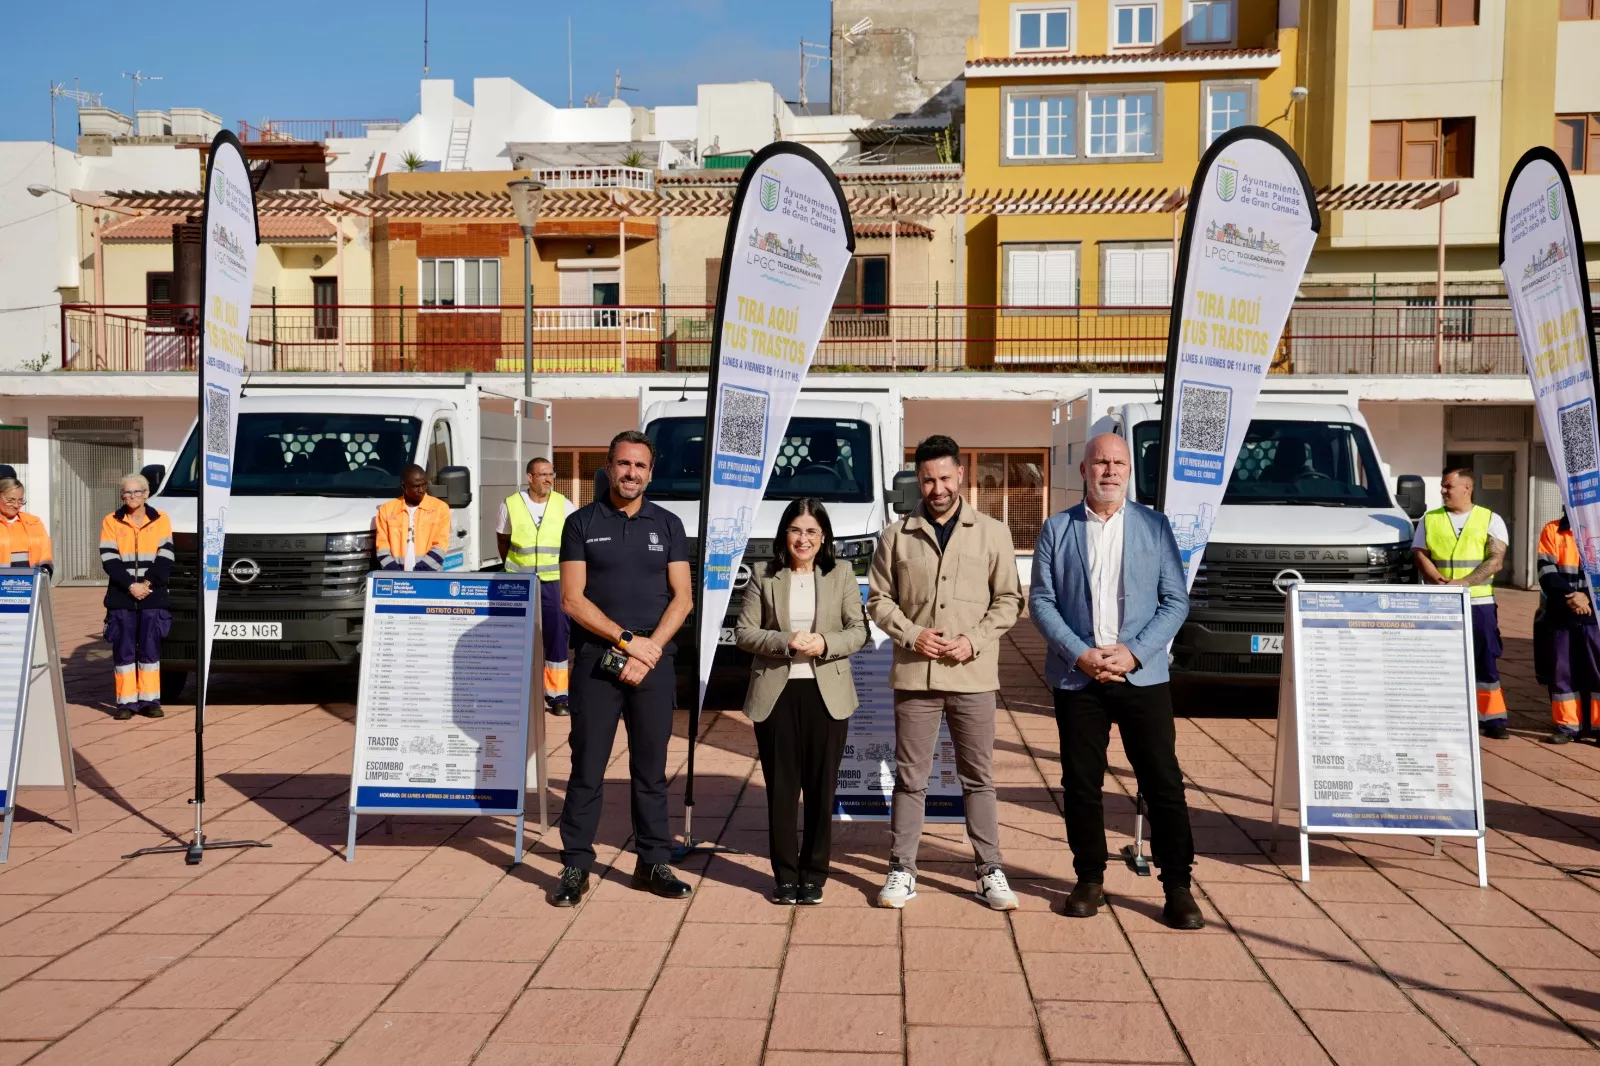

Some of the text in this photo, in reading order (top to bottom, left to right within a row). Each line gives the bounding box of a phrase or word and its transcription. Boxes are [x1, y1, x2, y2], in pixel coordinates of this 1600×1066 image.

[1242, 174, 1300, 196] Ayuntamiento
[784, 186, 838, 215] Ayuntamiento
[1240, 194, 1299, 216] de Gran Canaria
[1241, 185, 1300, 206] de Las Palmas
[782, 206, 836, 234] de Gran Canaria
[783, 197, 837, 225] de Las Palmas
[746, 251, 776, 272] LPGC
[1204, 245, 1235, 263] LPGC
[737, 295, 800, 335] TIRA AQUÍ
[1196, 289, 1262, 325] TIRA AQUÍ
[724, 321, 806, 365] TUS TRASTOS
[1182, 318, 1269, 356] TUS TRASTOS
[722, 355, 739, 369] LUNES
[739, 359, 743, 369] A
[744, 360, 766, 375] VIERNES
[766, 365, 773, 376] DE
[773, 367, 780, 378] 11
[785, 370, 791, 380] 17
[1181, 352, 1198, 365] LUNES
[1199, 355, 1204, 364] A
[1204, 355, 1226, 369] VIERNES
[1227, 359, 1235, 370] DE
[1247, 362, 1254, 372] 17
[1225, 549, 1350, 561] INTERSTAR
[228, 567, 261, 575] NISSAN
[213, 624, 279, 637] 7483 NGR
[1348, 620, 1376, 628] DISTRITO
[368, 736, 399, 747] TRASTOS
[366, 760, 404, 771] ESCOMBRO
[1312, 754, 1345, 765] TRASTOS
[365, 771, 389, 781] LIMPIO
[1313, 780, 1353, 791] ESCOMBRO
[1314, 790, 1339, 800] LIMPIO
